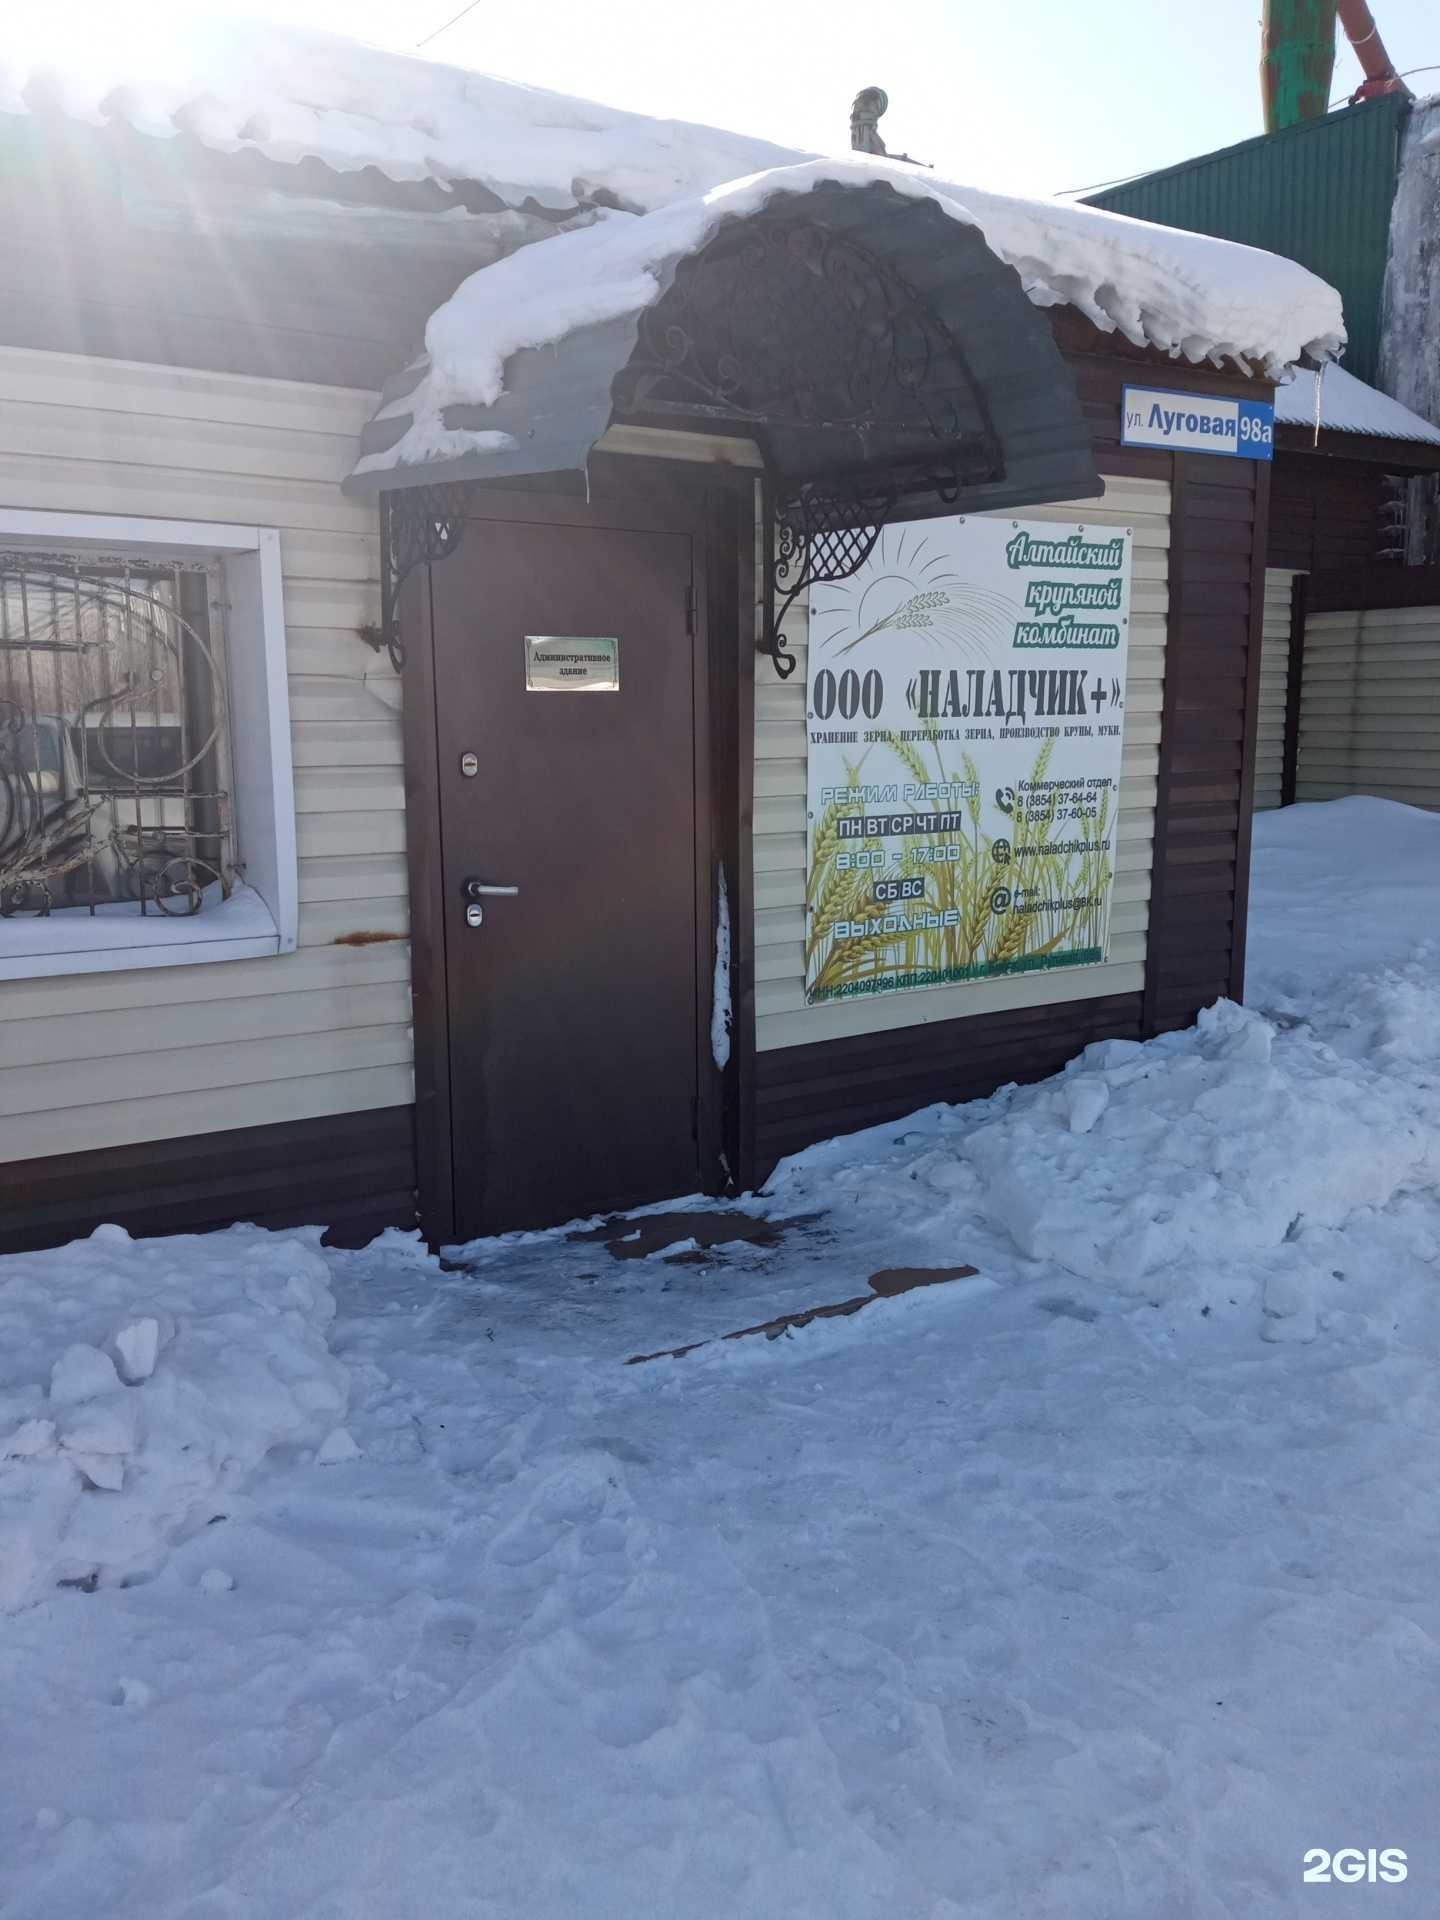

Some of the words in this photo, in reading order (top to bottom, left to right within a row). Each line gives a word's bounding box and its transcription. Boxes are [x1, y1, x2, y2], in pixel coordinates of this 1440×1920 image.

[1126, 411, 1144, 428] ул.
[1148, 403, 1236, 437] Луговая
[1240, 416, 1272, 443] 98а
[1008, 534, 1121, 567] Алтайский
[1028, 582, 1120, 613] крупяной
[1016, 618, 1118, 645] комбинат
[533, 651, 611, 663] Административное
[559, 667, 587, 676] здание
[813, 668, 884, 720] ООО
[905, 669, 1121, 726] «НАЛАДЧИК+»
[810, 730, 858, 744] ХРАНЕНИЕ
[863, 730, 895, 744] ЗЕРНА,
[899, 728, 960, 742] ПЕРЕРАБОТКА
[964, 727, 995, 741] ЗЕРНА,
[1000, 726, 1060, 739] ПРОИЗВОДСТВО
[1064, 726, 1094, 737] КРУПЫ,
[821, 784, 898, 805] РЕЖИМ
[1018, 777, 1084, 792] Коммерческий
[1087, 777, 1112, 790] отдел
[1017, 796, 1024, 807] 8
[1026, 793, 1056, 808] (3854)
[1057, 791, 1097, 805] 37-64-64
[839, 820, 862, 836] ПН
[867, 818, 887, 834] ВТ
[891, 817, 913, 833] СР
[916, 815, 937, 831] ЧТ
[940, 813, 960, 830] ПТ
[1016, 811, 1023, 823] 8
[1026, 808, 1055, 823] (3854)
[1057, 807, 1097, 820] 37-60-05
[836, 850, 886, 870] 8:00
[911, 844, 961, 864] 17:00
[1014, 838, 1110, 857] www.naladchikplus.ru
[875, 883, 898, 900] СБ
[901, 880, 922, 897] ВС
[833, 908, 961, 939] ВЫХОДНЫЕ
